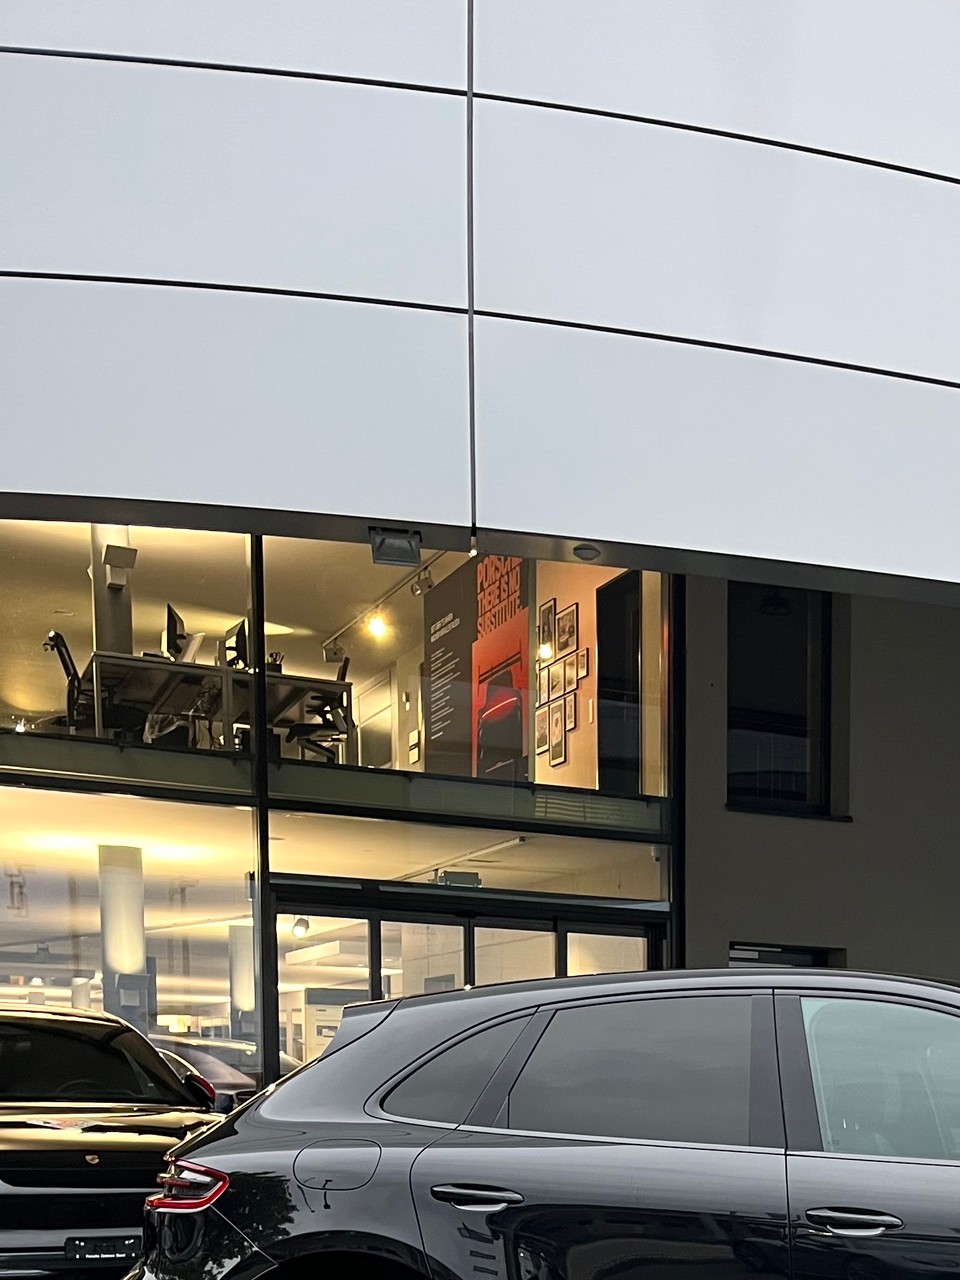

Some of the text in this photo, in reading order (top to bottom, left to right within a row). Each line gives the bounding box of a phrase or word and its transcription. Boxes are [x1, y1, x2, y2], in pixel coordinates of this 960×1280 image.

[477, 564, 520, 617] THERE IS NO
